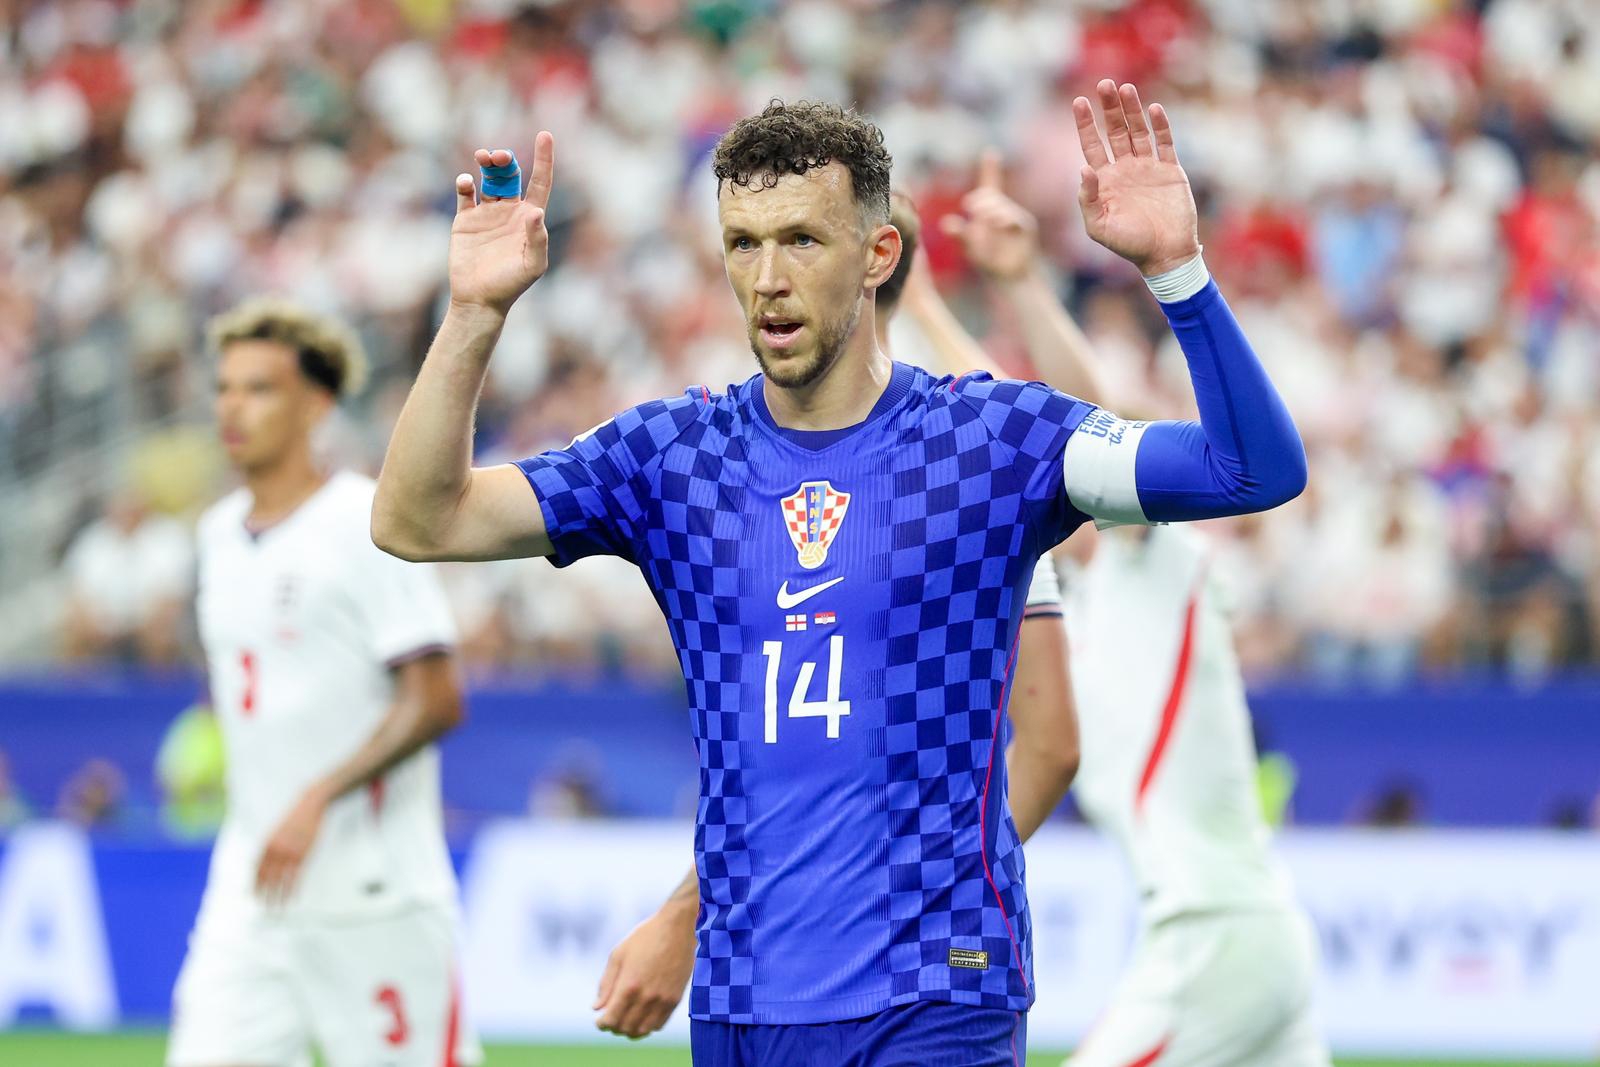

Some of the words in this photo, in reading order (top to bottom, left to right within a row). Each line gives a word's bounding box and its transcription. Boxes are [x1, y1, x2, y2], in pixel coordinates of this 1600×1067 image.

[809, 491, 821, 535] HNS
[763, 635, 851, 743] 14
[374, 984, 411, 1046] 3
